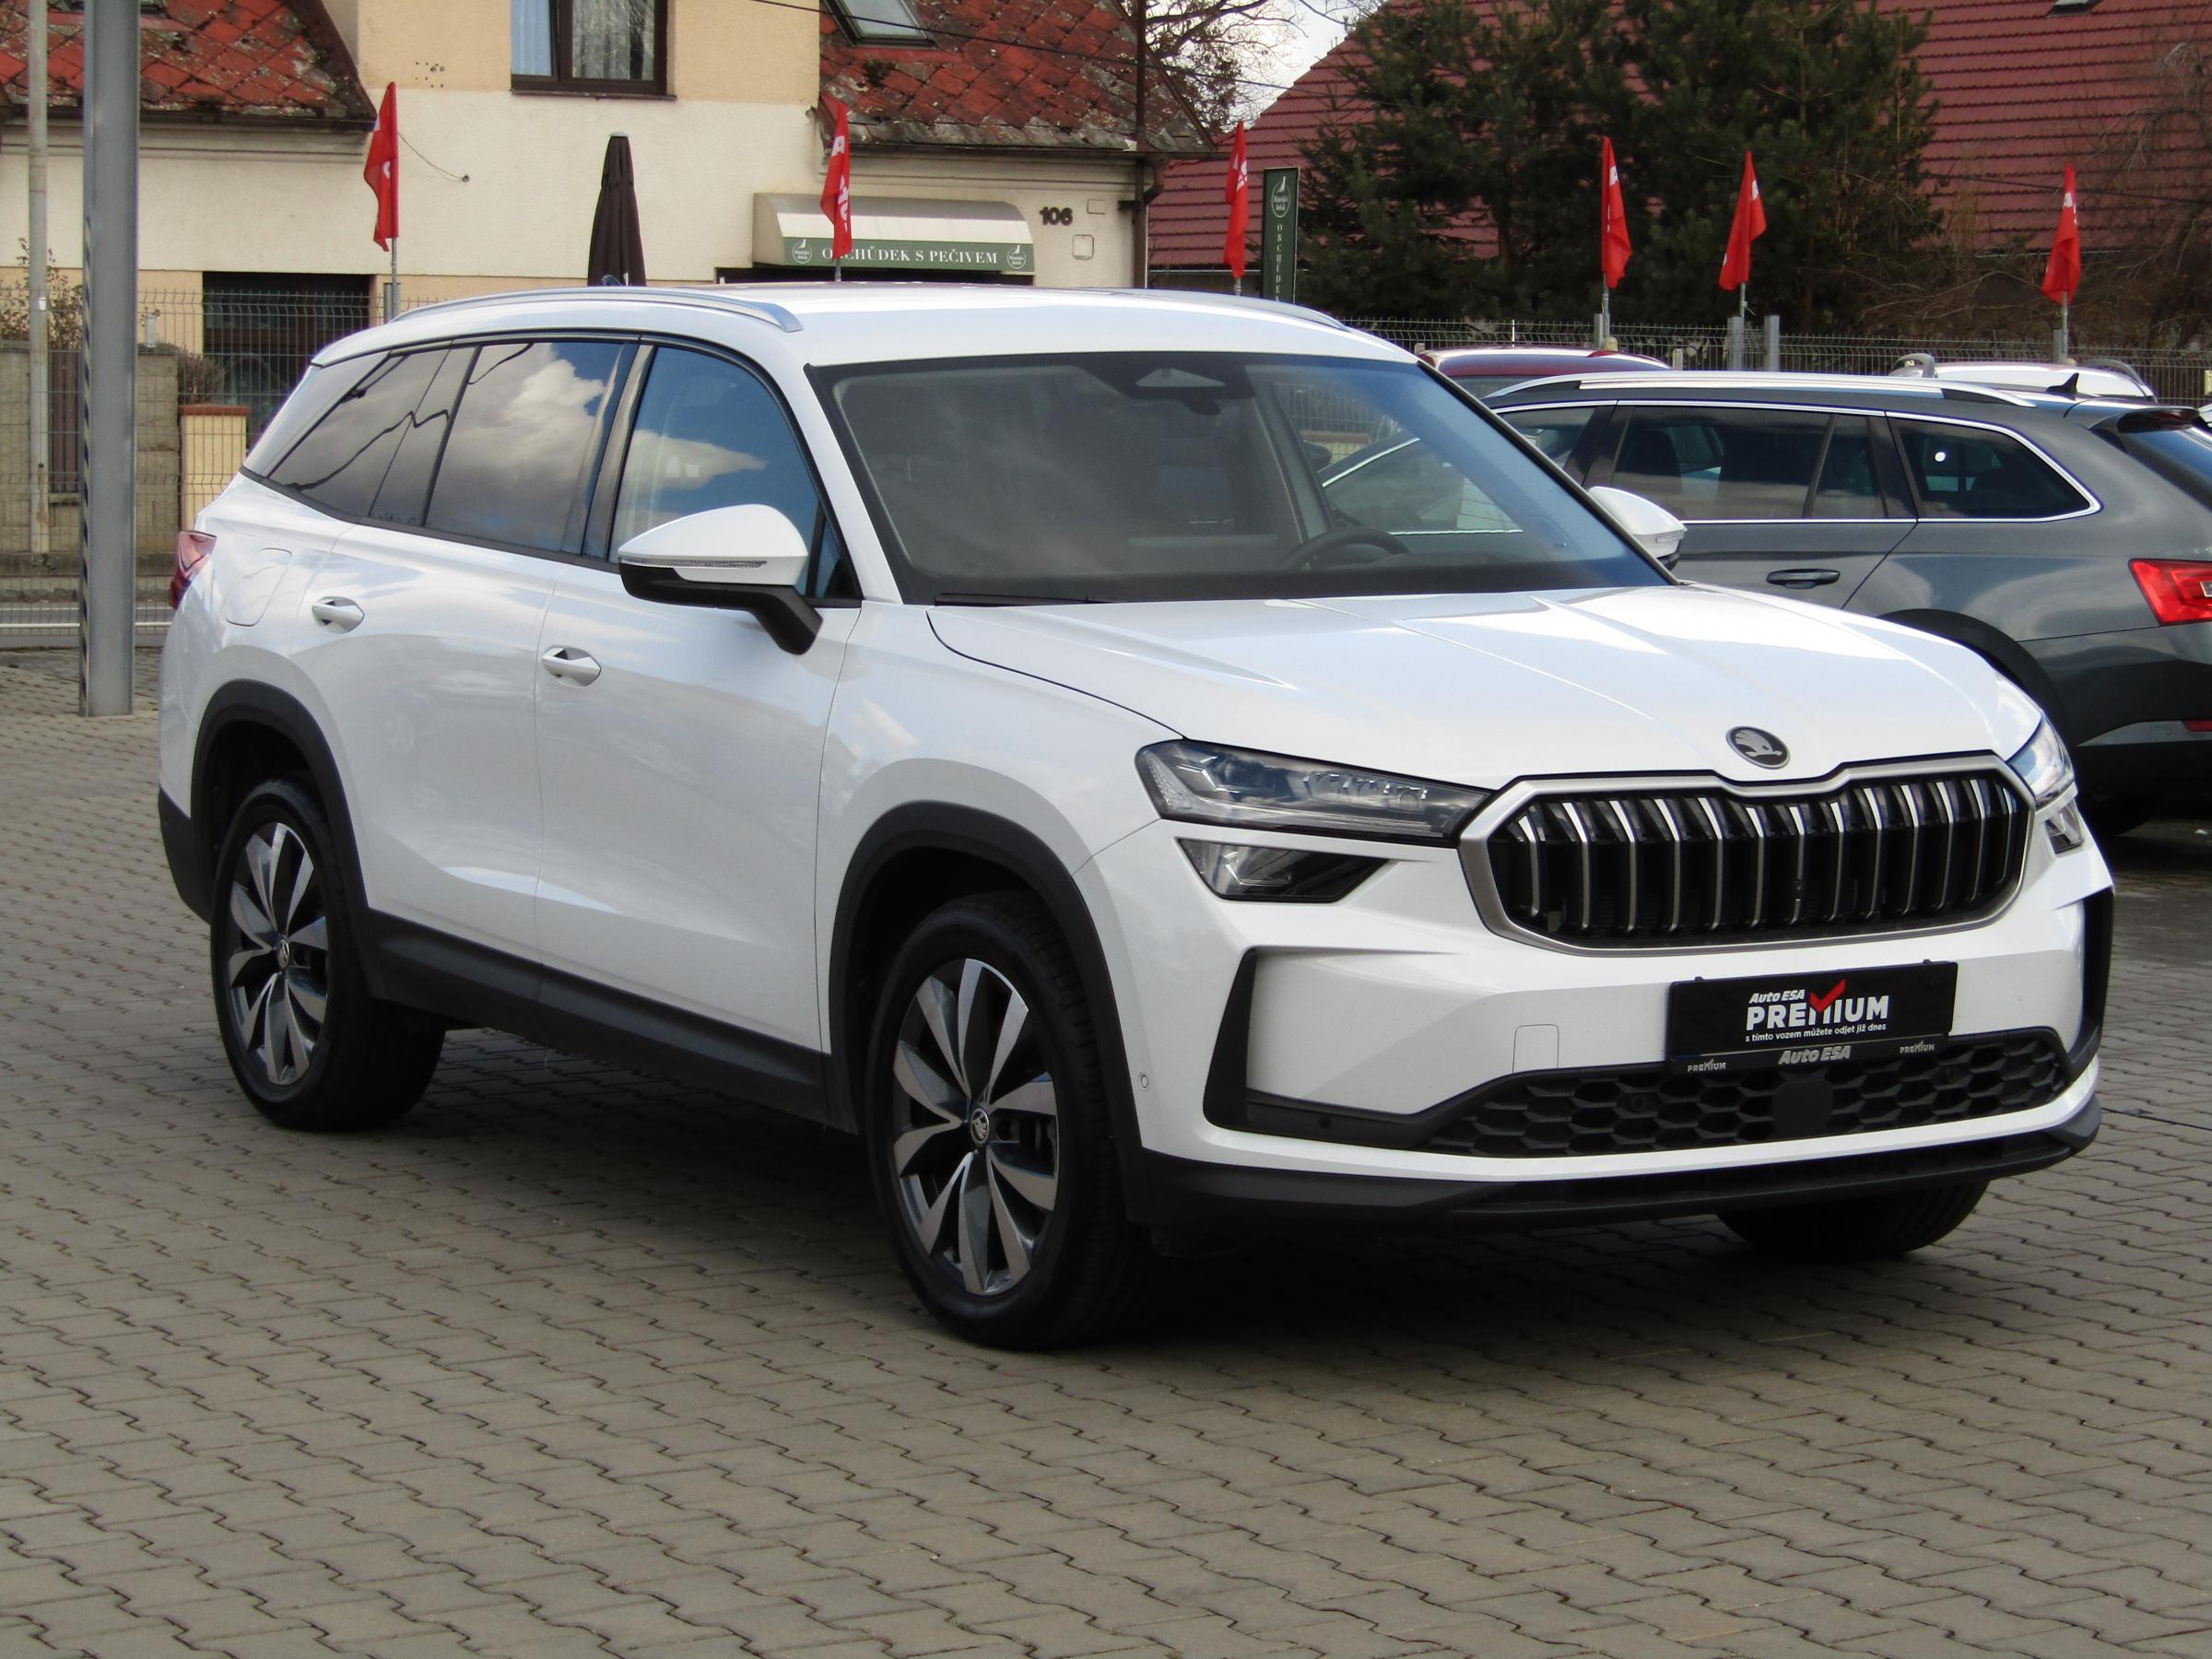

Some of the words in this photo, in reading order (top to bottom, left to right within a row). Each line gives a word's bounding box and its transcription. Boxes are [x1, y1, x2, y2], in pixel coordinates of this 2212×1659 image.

[1039, 206, 1073, 226] 106
[822, 245, 911, 262] OCHŮDEK
[915, 250, 924, 262] S
[929, 248, 997, 264] PEČIVEM
[1748, 992, 1780, 1004] Auto
[1781, 989, 1806, 1002] ESA
[1746, 994, 1889, 1031] PREMIUM
[1775, 1031, 1802, 1040] vozem
[1803, 1028, 1832, 1037] můžete
[1834, 1025, 1855, 1035] odjet
[1856, 1023, 1866, 1034] již
[1867, 1023, 1887, 1031] dnes
[1777, 1049, 1820, 1065] Auto
[1819, 1044, 1852, 1062] ESA
[1900, 1041, 1935, 1054] PREMIUM
[1688, 1059, 1726, 1073] PREMIUM
